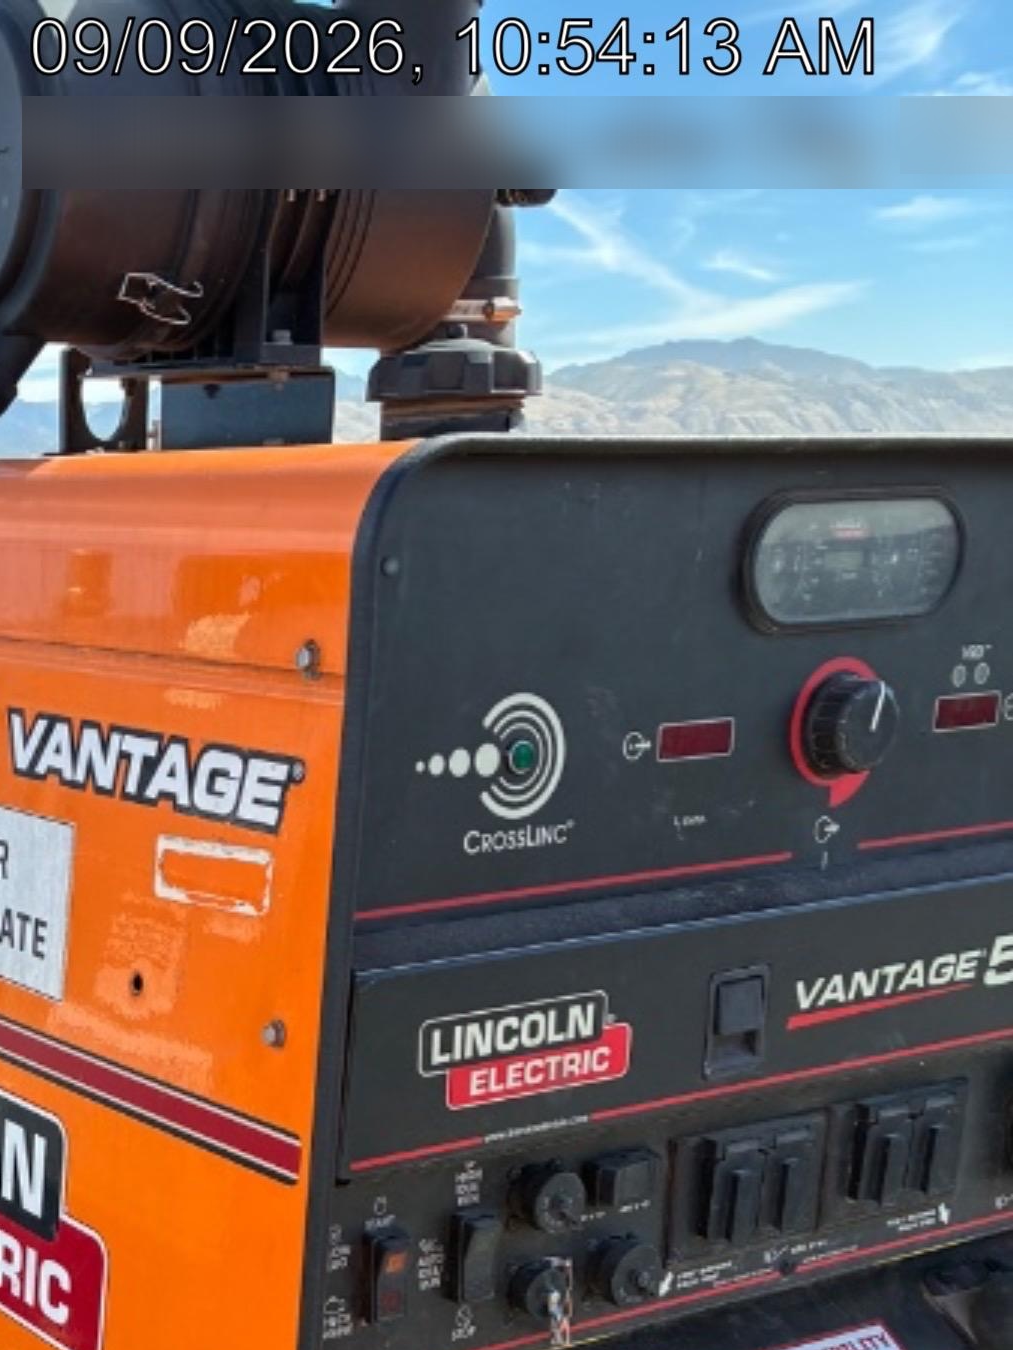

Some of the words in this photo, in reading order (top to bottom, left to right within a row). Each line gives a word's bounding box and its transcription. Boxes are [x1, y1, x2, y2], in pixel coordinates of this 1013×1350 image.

[8, 708, 293, 833] VANTAGE
[796, 949, 982, 1010] VANTAGE
[429, 1003, 597, 1067] LINCOLN
[468, 1046, 612, 1099] ELECTRIC
